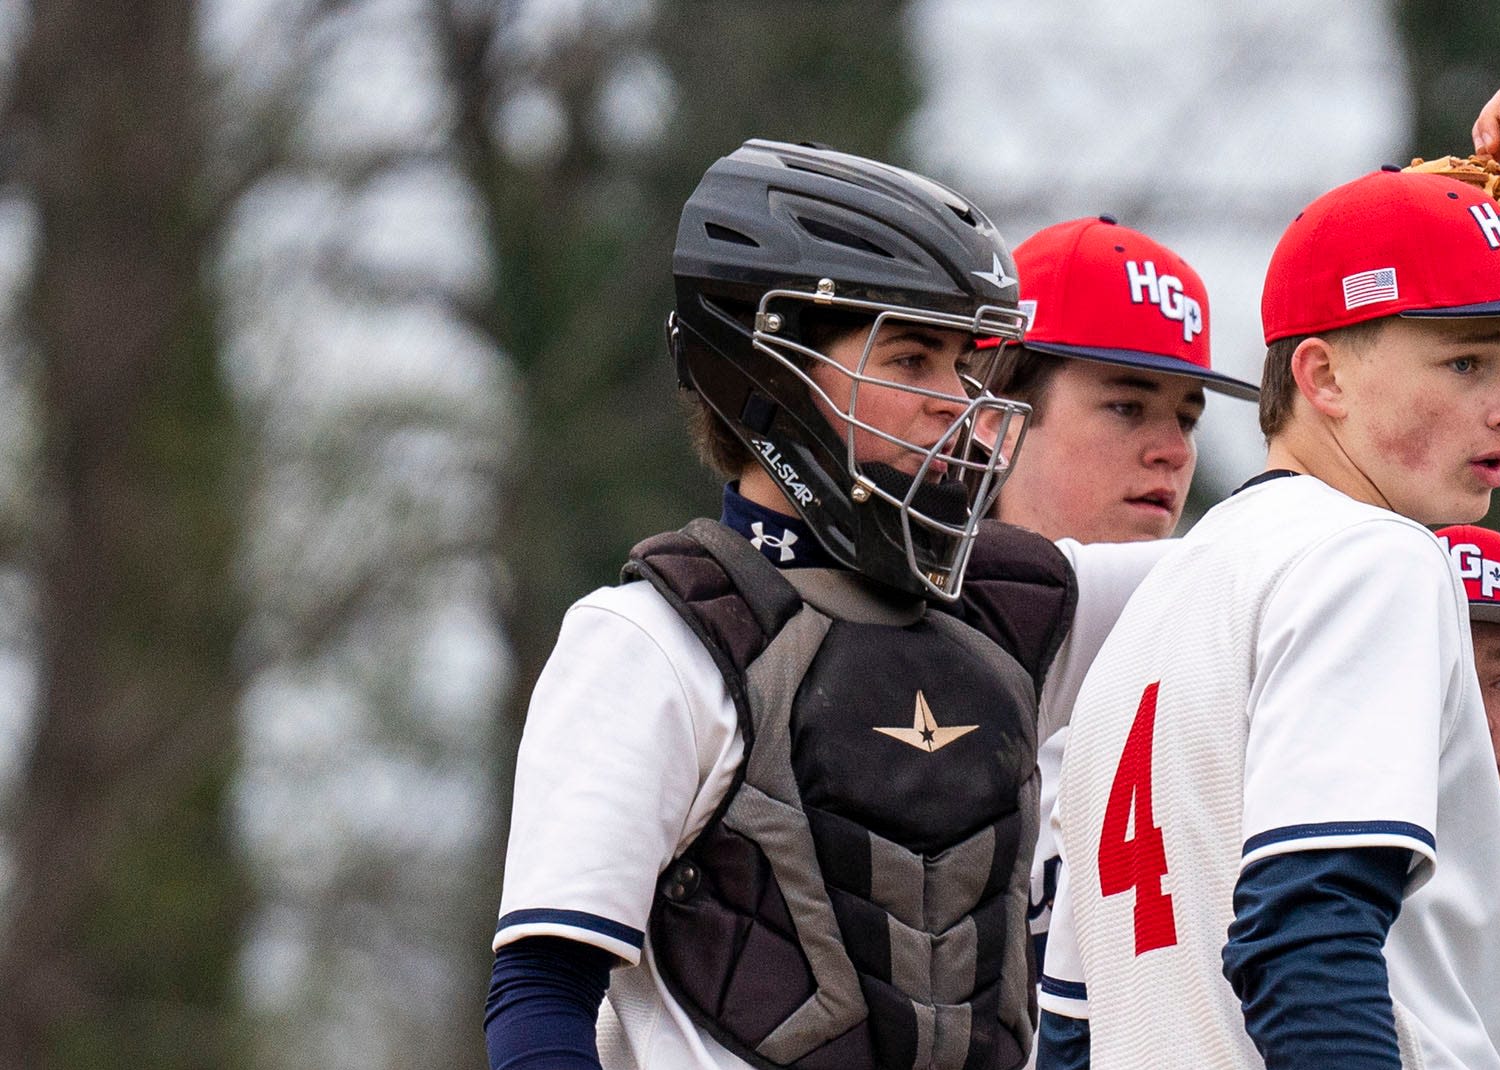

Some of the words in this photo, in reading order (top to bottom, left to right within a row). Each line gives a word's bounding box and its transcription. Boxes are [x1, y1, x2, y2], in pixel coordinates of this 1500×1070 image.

[1125, 260, 1203, 343] HGP
[752, 439, 814, 507] ALL-STAR
[1098, 680, 1178, 957] 4
